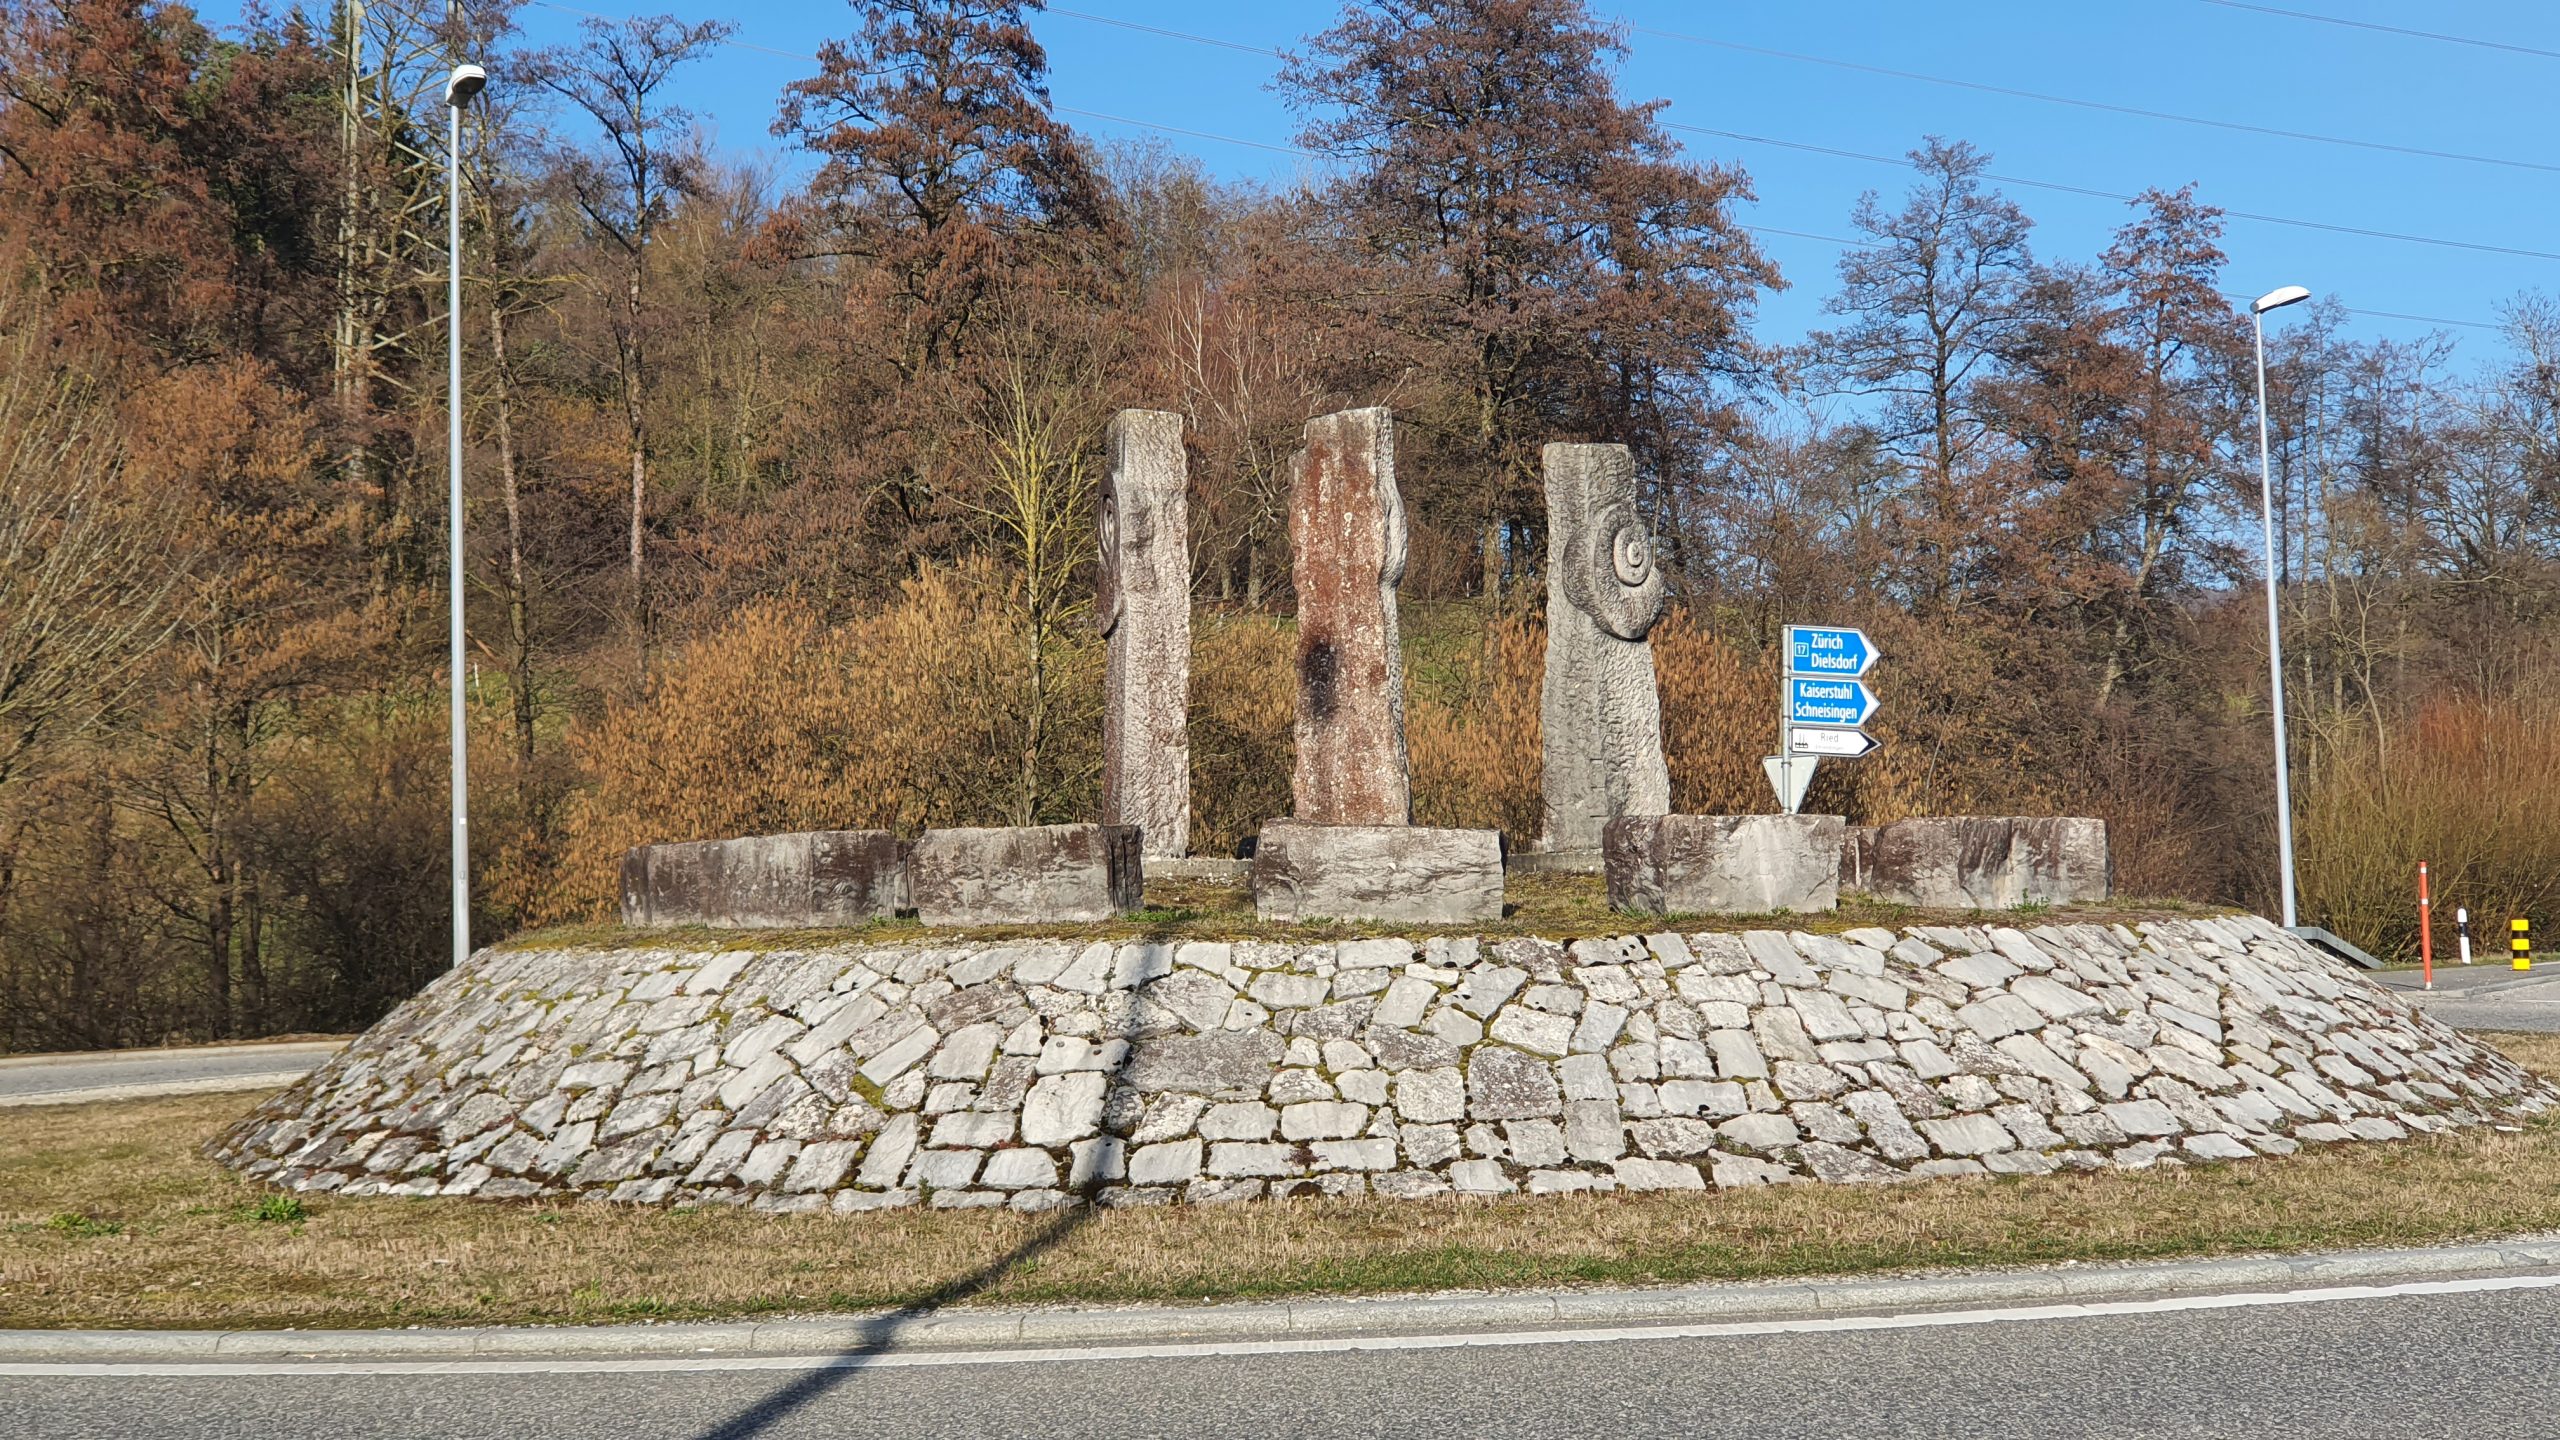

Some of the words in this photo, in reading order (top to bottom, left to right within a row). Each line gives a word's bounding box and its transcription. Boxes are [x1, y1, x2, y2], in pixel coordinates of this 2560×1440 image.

[1811, 633, 1843, 650] Zürich
[1797, 645, 1806, 655] 17
[1811, 654, 1857, 670] Dielsdorf
[1800, 683, 1853, 700] Kaiserstuhl
[1795, 702, 1857, 722] Schneisingen
[1820, 733, 1839, 743] Ried
